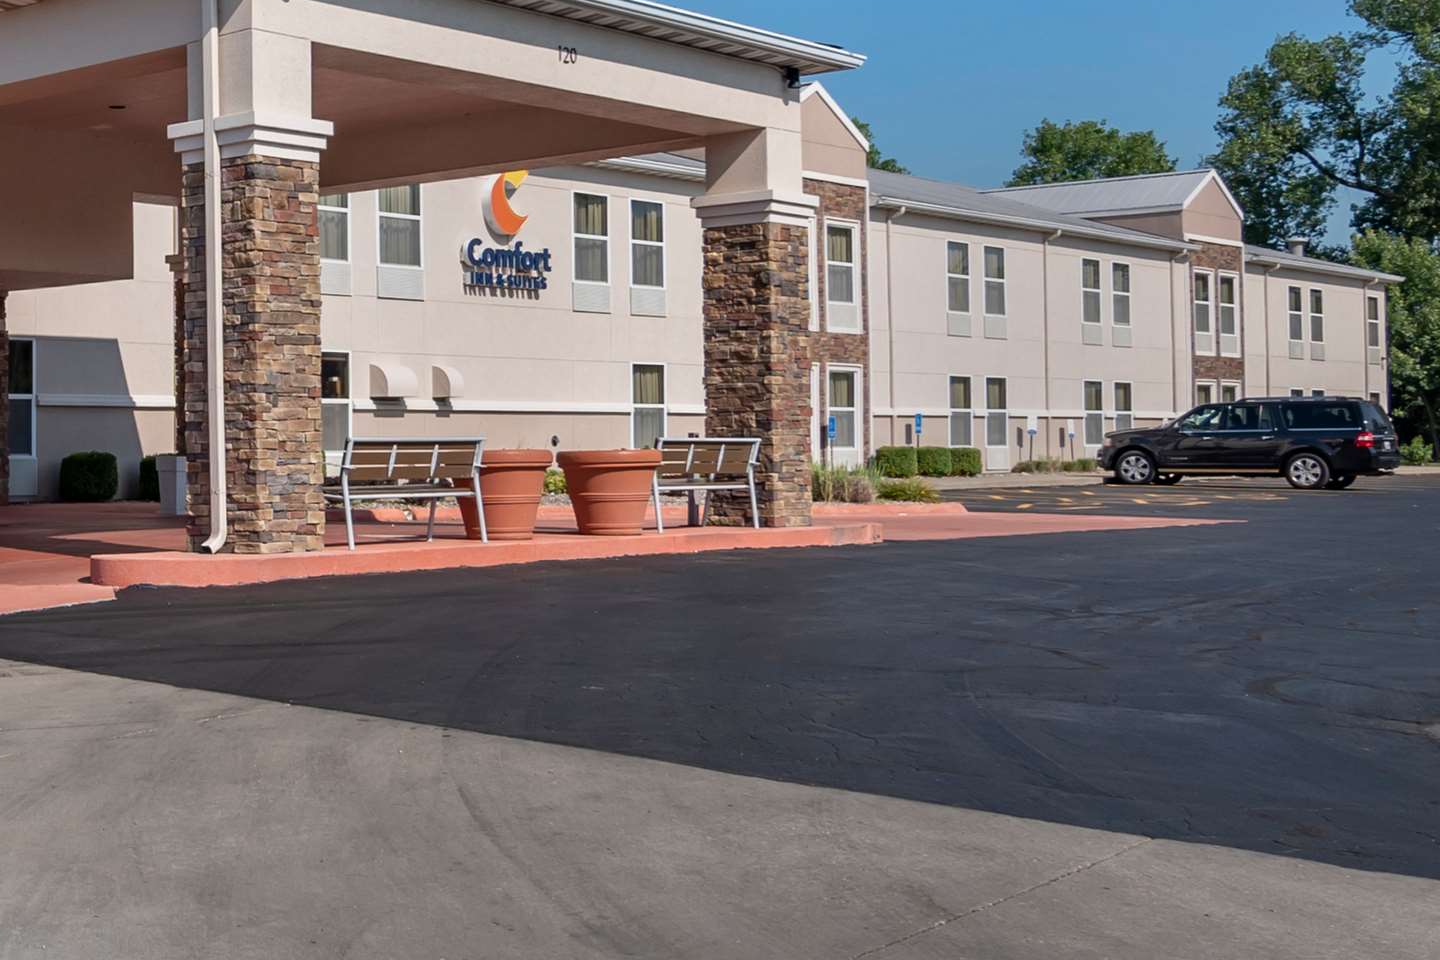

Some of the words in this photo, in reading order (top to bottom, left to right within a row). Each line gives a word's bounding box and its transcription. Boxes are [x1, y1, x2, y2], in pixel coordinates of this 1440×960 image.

[558, 45, 577, 64] 120
[467, 238, 552, 272] Comfort
[470, 271, 493, 286] INN
[496, 273, 505, 287] &
[506, 274, 548, 290] SUITES
